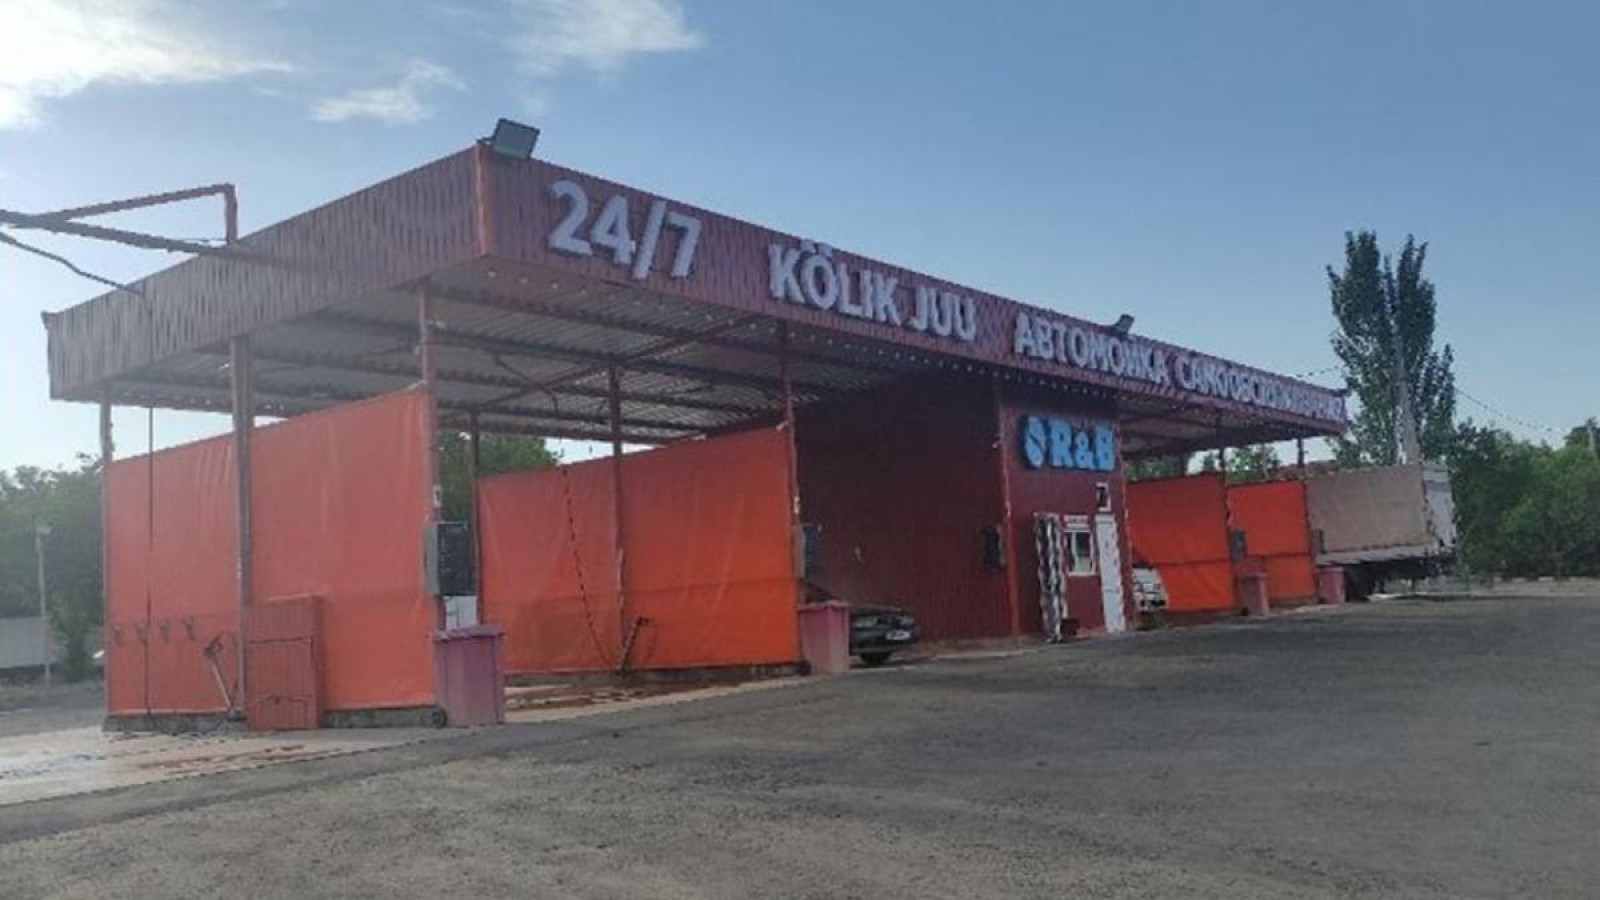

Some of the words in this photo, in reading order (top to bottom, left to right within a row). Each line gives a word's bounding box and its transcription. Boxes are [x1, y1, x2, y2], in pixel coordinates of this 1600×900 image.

[548, 180, 702, 279] 24/7
[768, 239, 902, 326] KÖLIK
[910, 288, 977, 341] JUU
[1050, 420, 1116, 471] R&B
